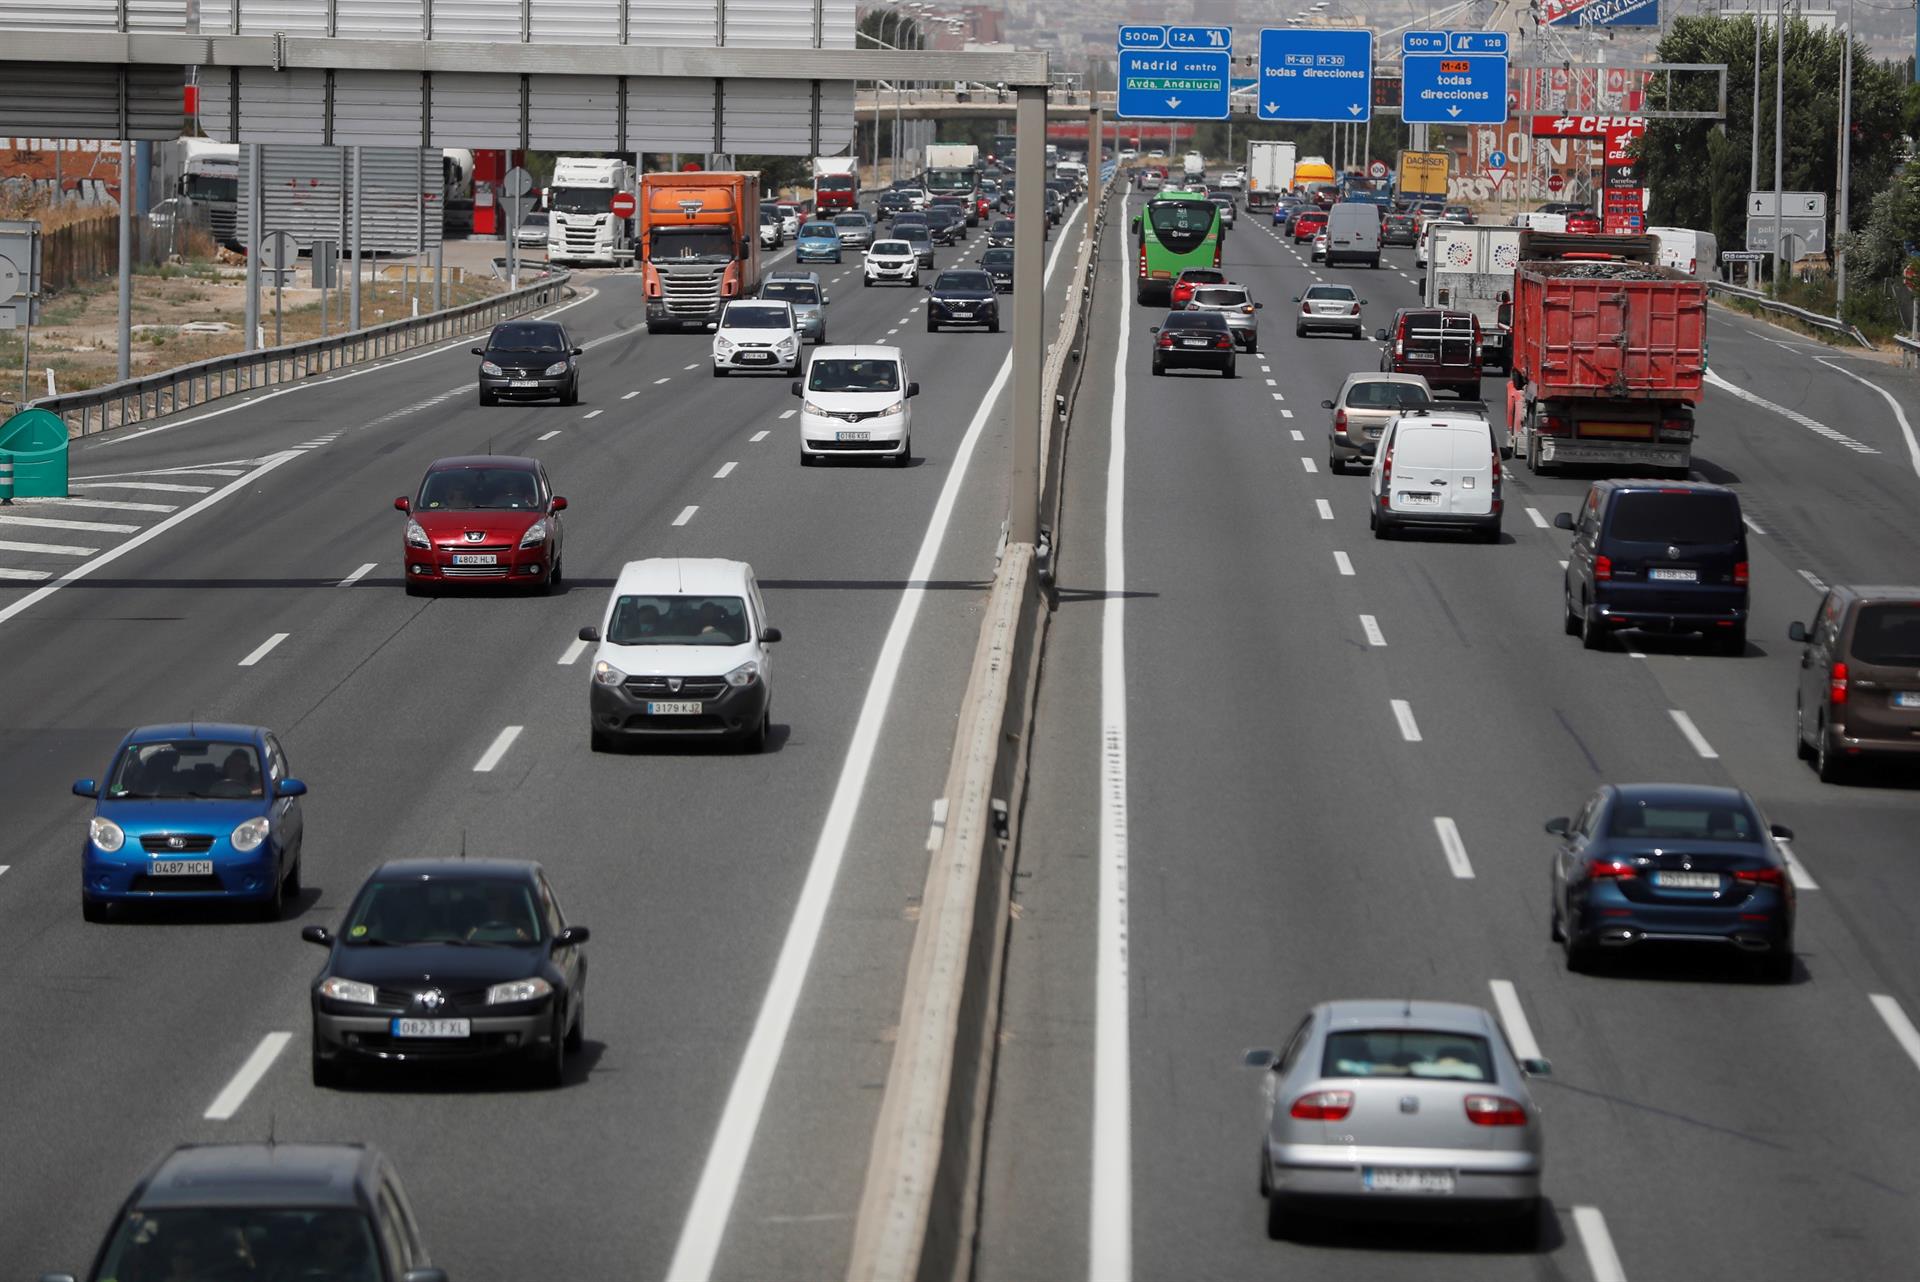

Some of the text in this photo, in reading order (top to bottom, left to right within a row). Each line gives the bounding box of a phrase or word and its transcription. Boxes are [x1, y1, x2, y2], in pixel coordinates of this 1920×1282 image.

[1125, 32, 1159, 41] 500m
[1174, 33, 1195, 42] 12A
[1409, 38, 1442, 47] 500 m
[1484, 39, 1501, 47] 12B
[1318, 56, 1343, 64] M-30
[1131, 60, 1217, 71] Madrid centro
[1441, 62, 1469, 71] M-45
[1265, 67, 1365, 78] todas direcciones
[1128, 79, 1158, 88] Avda.
[1436, 75, 1472, 85] todas
[1420, 89, 1489, 99] direcciones
[1406, 156, 1444, 166] DACHSER
[458, 555, 496, 564] 4802 HLX
[655, 703, 679, 713] 3179
[154, 862, 210, 873] 0487 HCH
[402, 1022, 462, 1033] 0823 FXL
